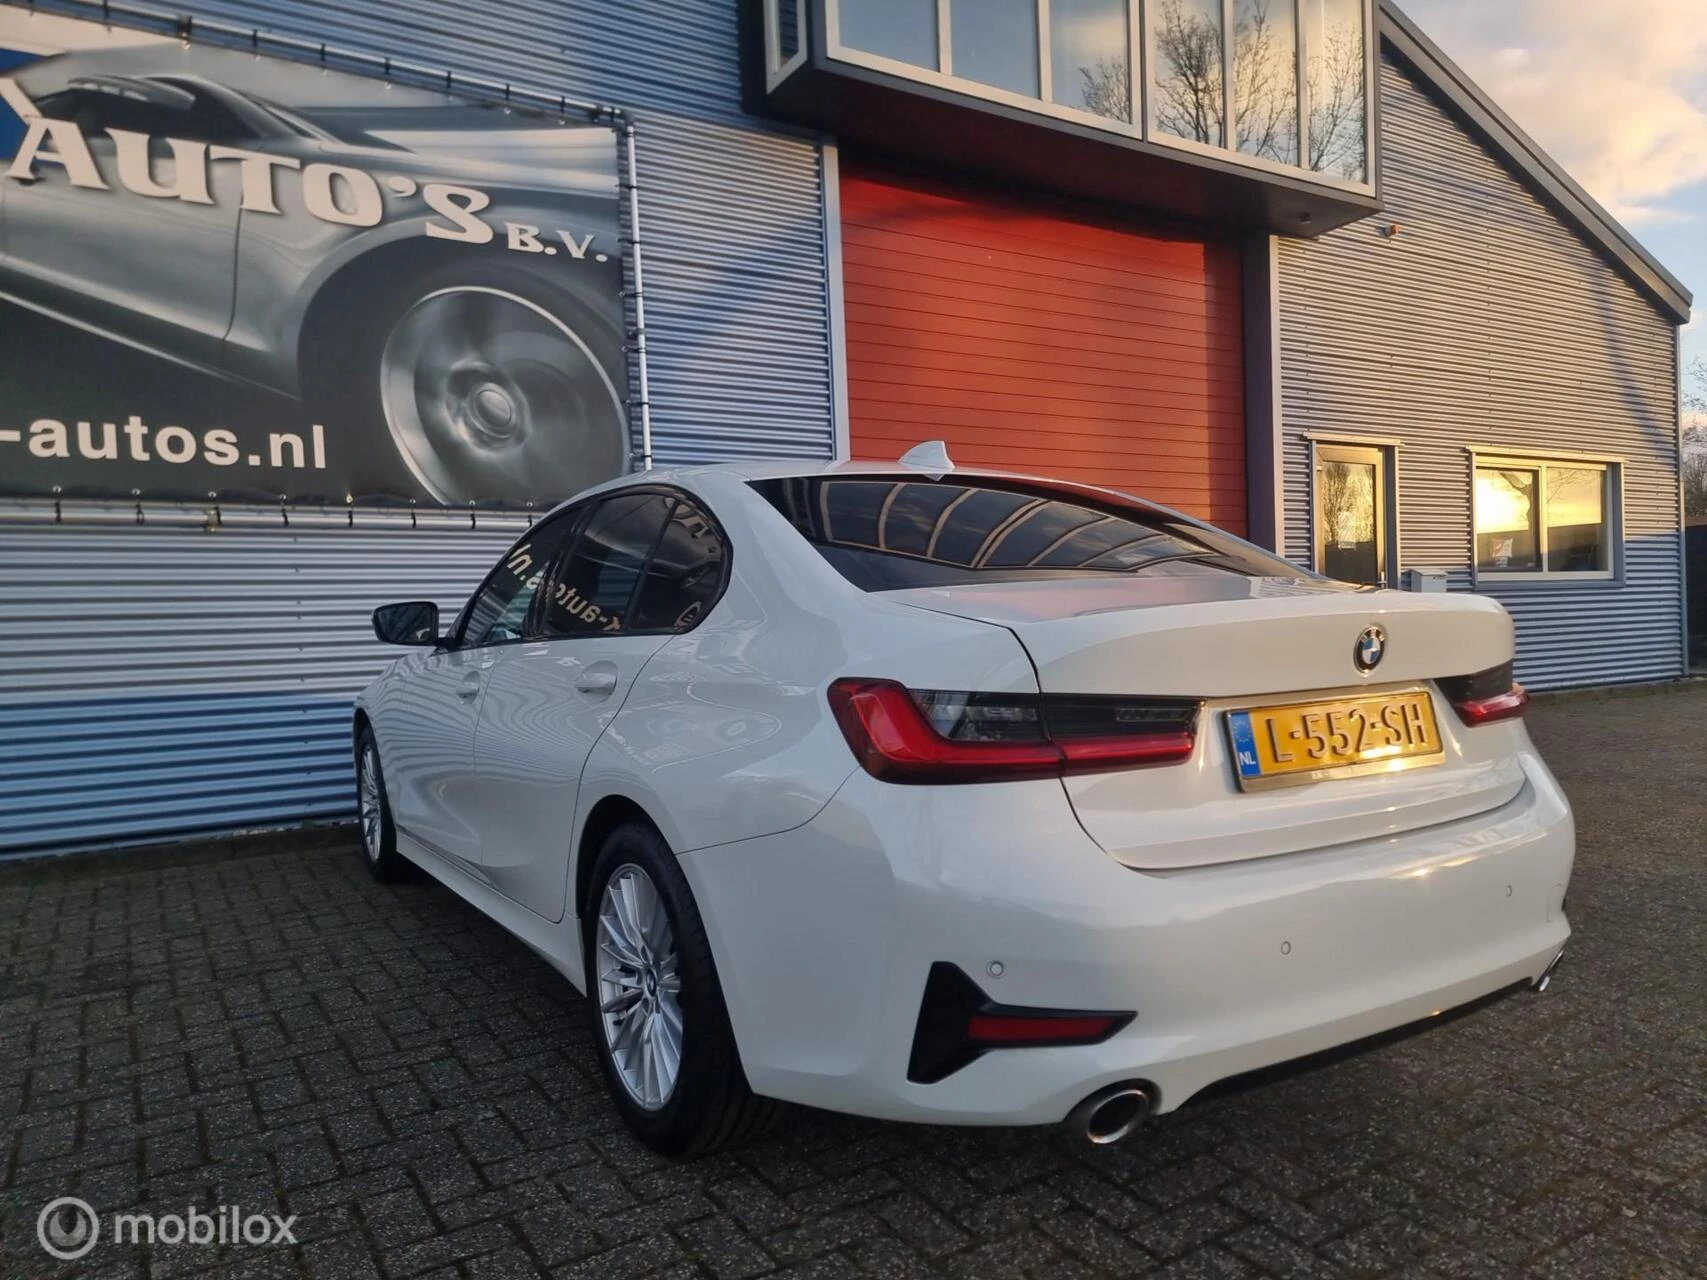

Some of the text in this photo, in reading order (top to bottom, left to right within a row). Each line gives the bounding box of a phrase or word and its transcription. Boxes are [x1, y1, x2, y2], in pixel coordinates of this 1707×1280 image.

[4, 116, 608, 263] AUTO'S B.V.
[1239, 750, 1257, 766] NL
[1266, 703, 1427, 763] L-552-SH
